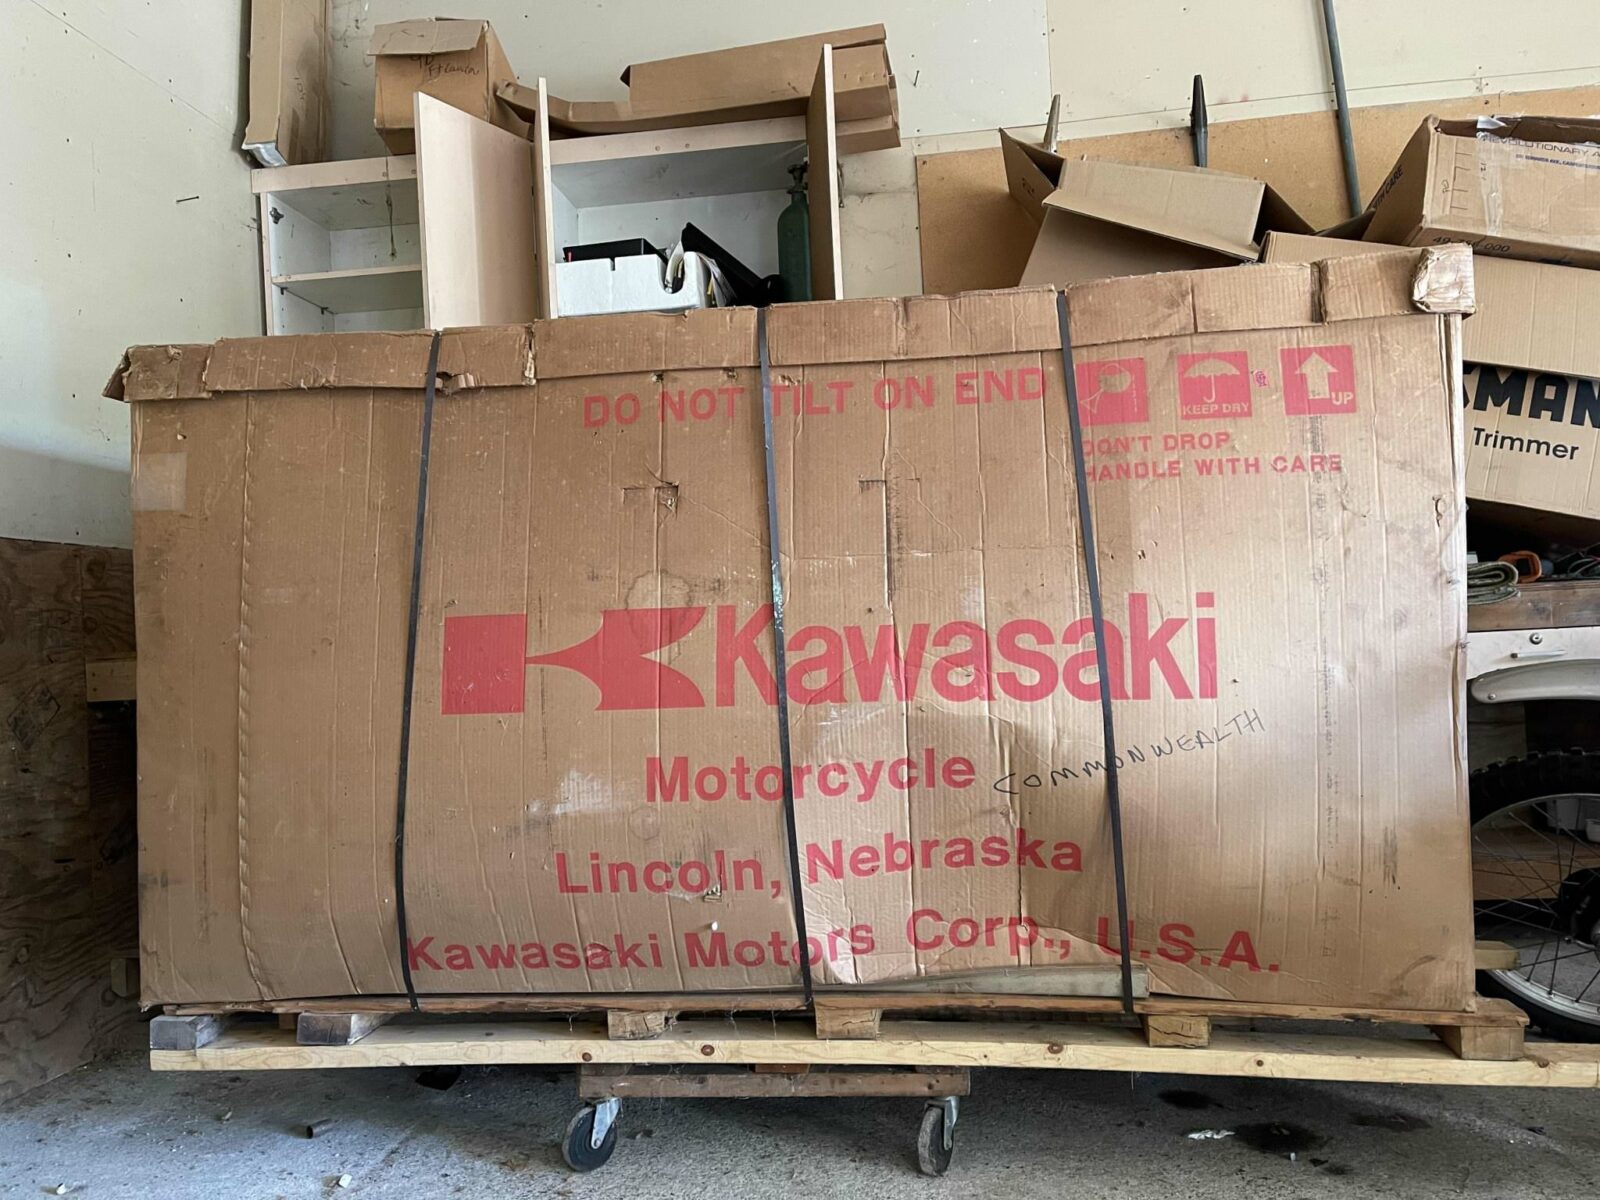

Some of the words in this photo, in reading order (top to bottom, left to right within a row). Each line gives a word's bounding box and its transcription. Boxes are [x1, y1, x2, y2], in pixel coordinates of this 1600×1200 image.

[583, 394, 641, 429] DO
[657, 386, 745, 423] NOT
[770, 380, 854, 417] TILT
[872, 375, 935, 410] ON
[954, 367, 1048, 406] END
[1182, 402, 1218, 416] KEEP
[1221, 402, 1249, 414] DRY
[1331, 391, 1354, 405] UP
[1163, 431, 1231, 452] DROP
[1473, 427, 1580, 460] Trimmer
[1195, 457, 1260, 477] WITH
[1271, 454, 1343, 474] CARE
[715, 591, 1218, 708] Kawasaki
[646, 747, 976, 803] Motorcycle
[555, 850, 782, 898] Lincoln,
[805, 828, 1083, 885] Nebraska
[407, 933, 662, 972] Kawasaki
[684, 923, 876, 968] Motors
[905, 908, 1072, 960] Corp.,
[1097, 916, 1280, 973] U.S.A.
